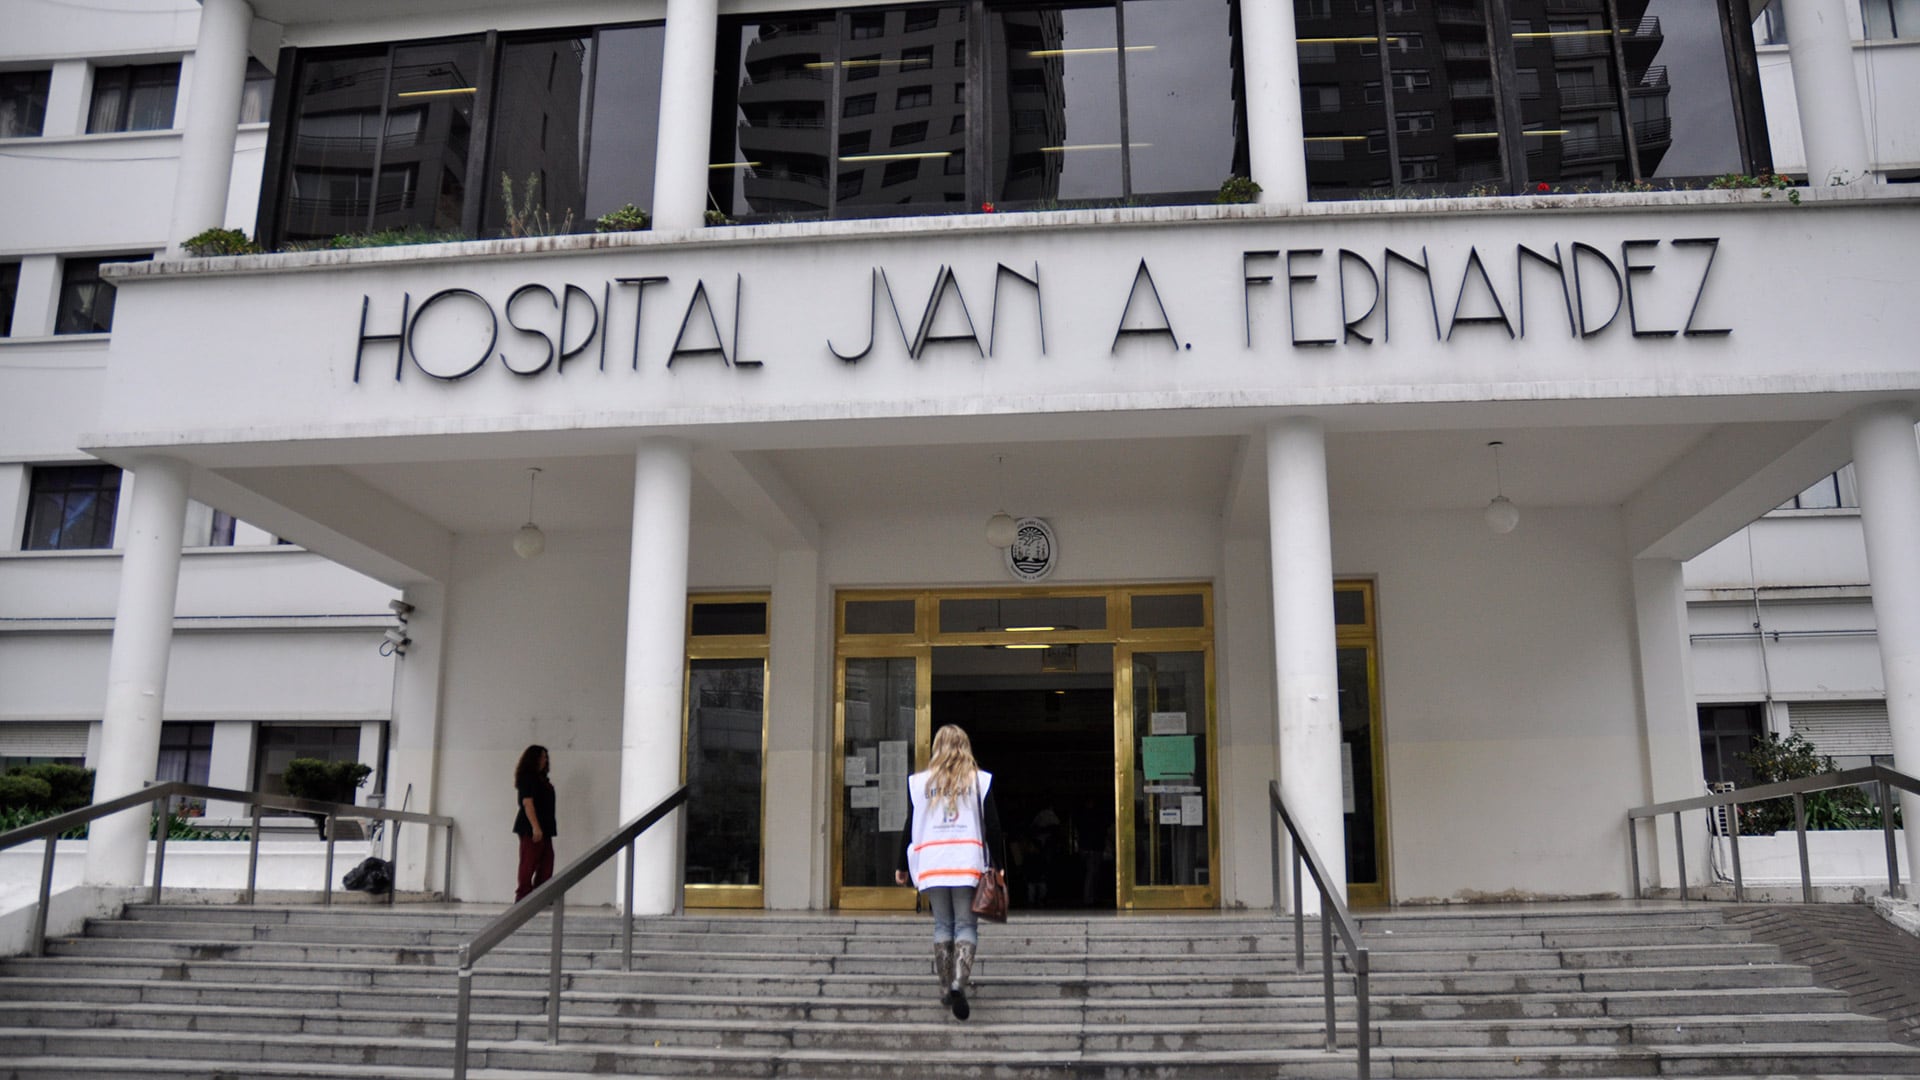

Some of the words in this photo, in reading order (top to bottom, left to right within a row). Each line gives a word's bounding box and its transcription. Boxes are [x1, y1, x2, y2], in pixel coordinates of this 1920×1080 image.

[353, 272, 764, 383] HOSPITAL
[1110, 256, 1192, 355] A.
[1242, 237, 1734, 348] FERNANDEZ
